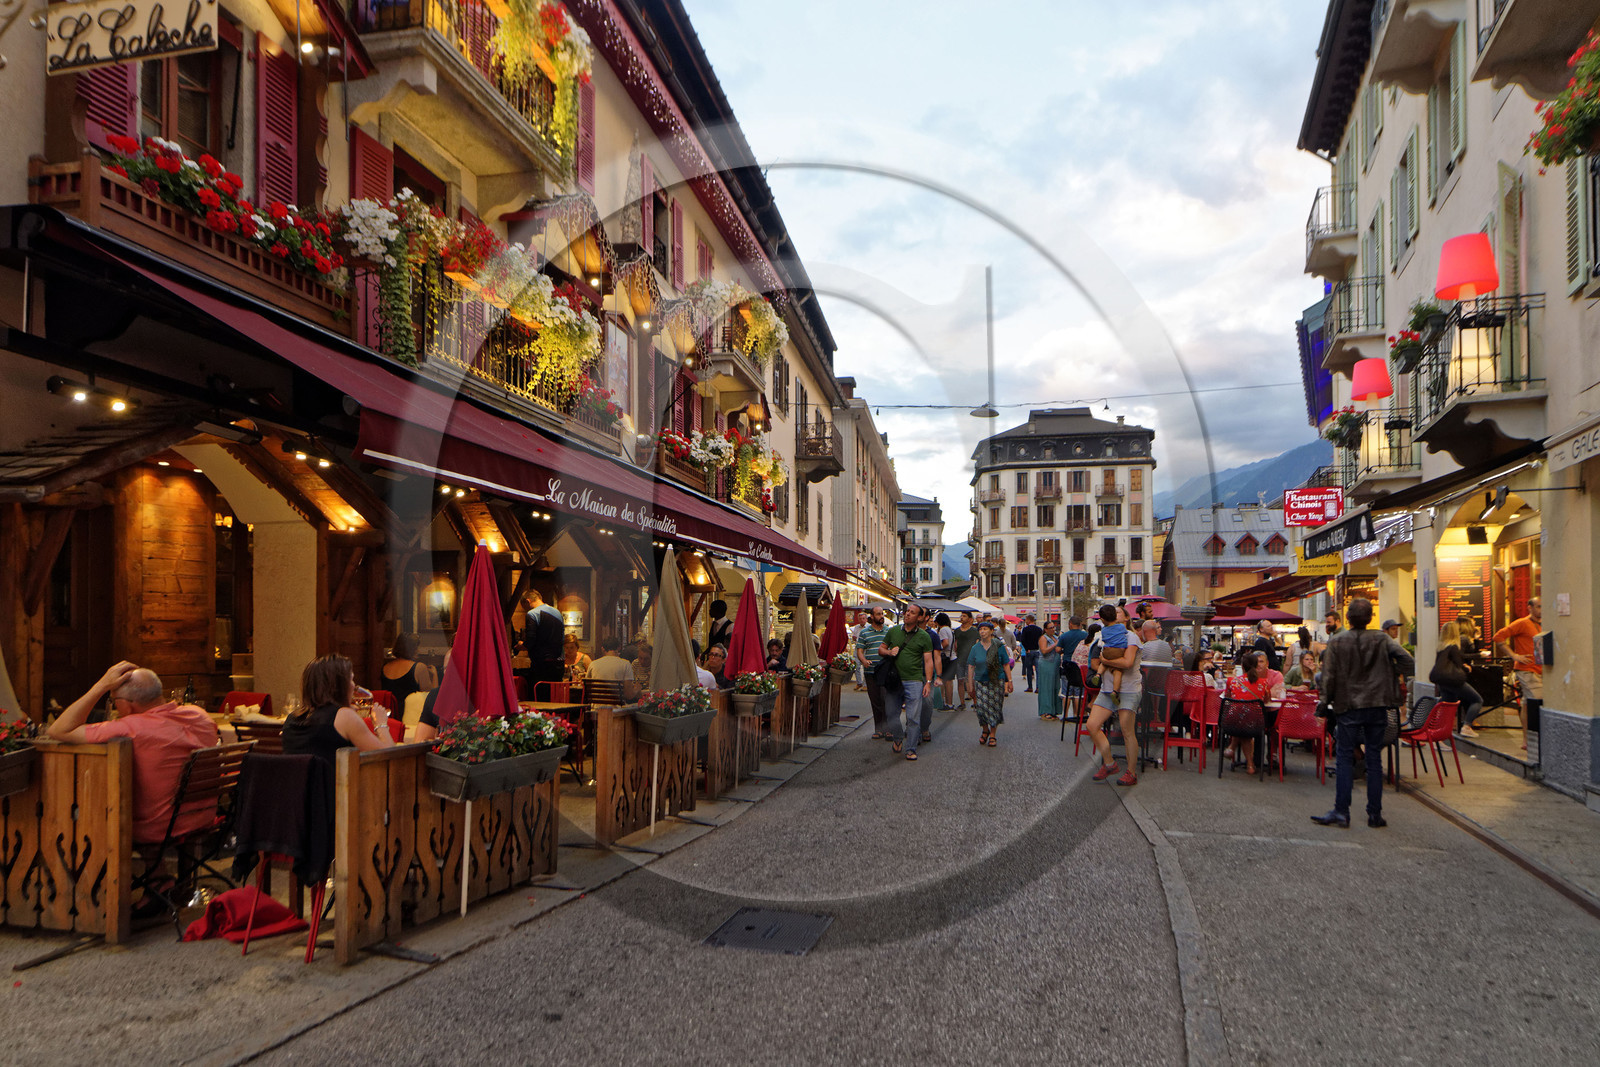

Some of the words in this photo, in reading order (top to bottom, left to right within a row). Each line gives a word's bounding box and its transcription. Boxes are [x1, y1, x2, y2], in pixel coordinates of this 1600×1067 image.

[1290, 493, 1336, 502] Restaurant
[545, 478, 566, 505] La
[569, 487, 618, 518] Maison
[621, 503, 635, 523] des
[636, 505, 677, 535] Spécialités
[1290, 501, 1322, 509] Chinois
[1290, 513, 1307, 521] Chez
[1308, 512, 1324, 522] Yang
